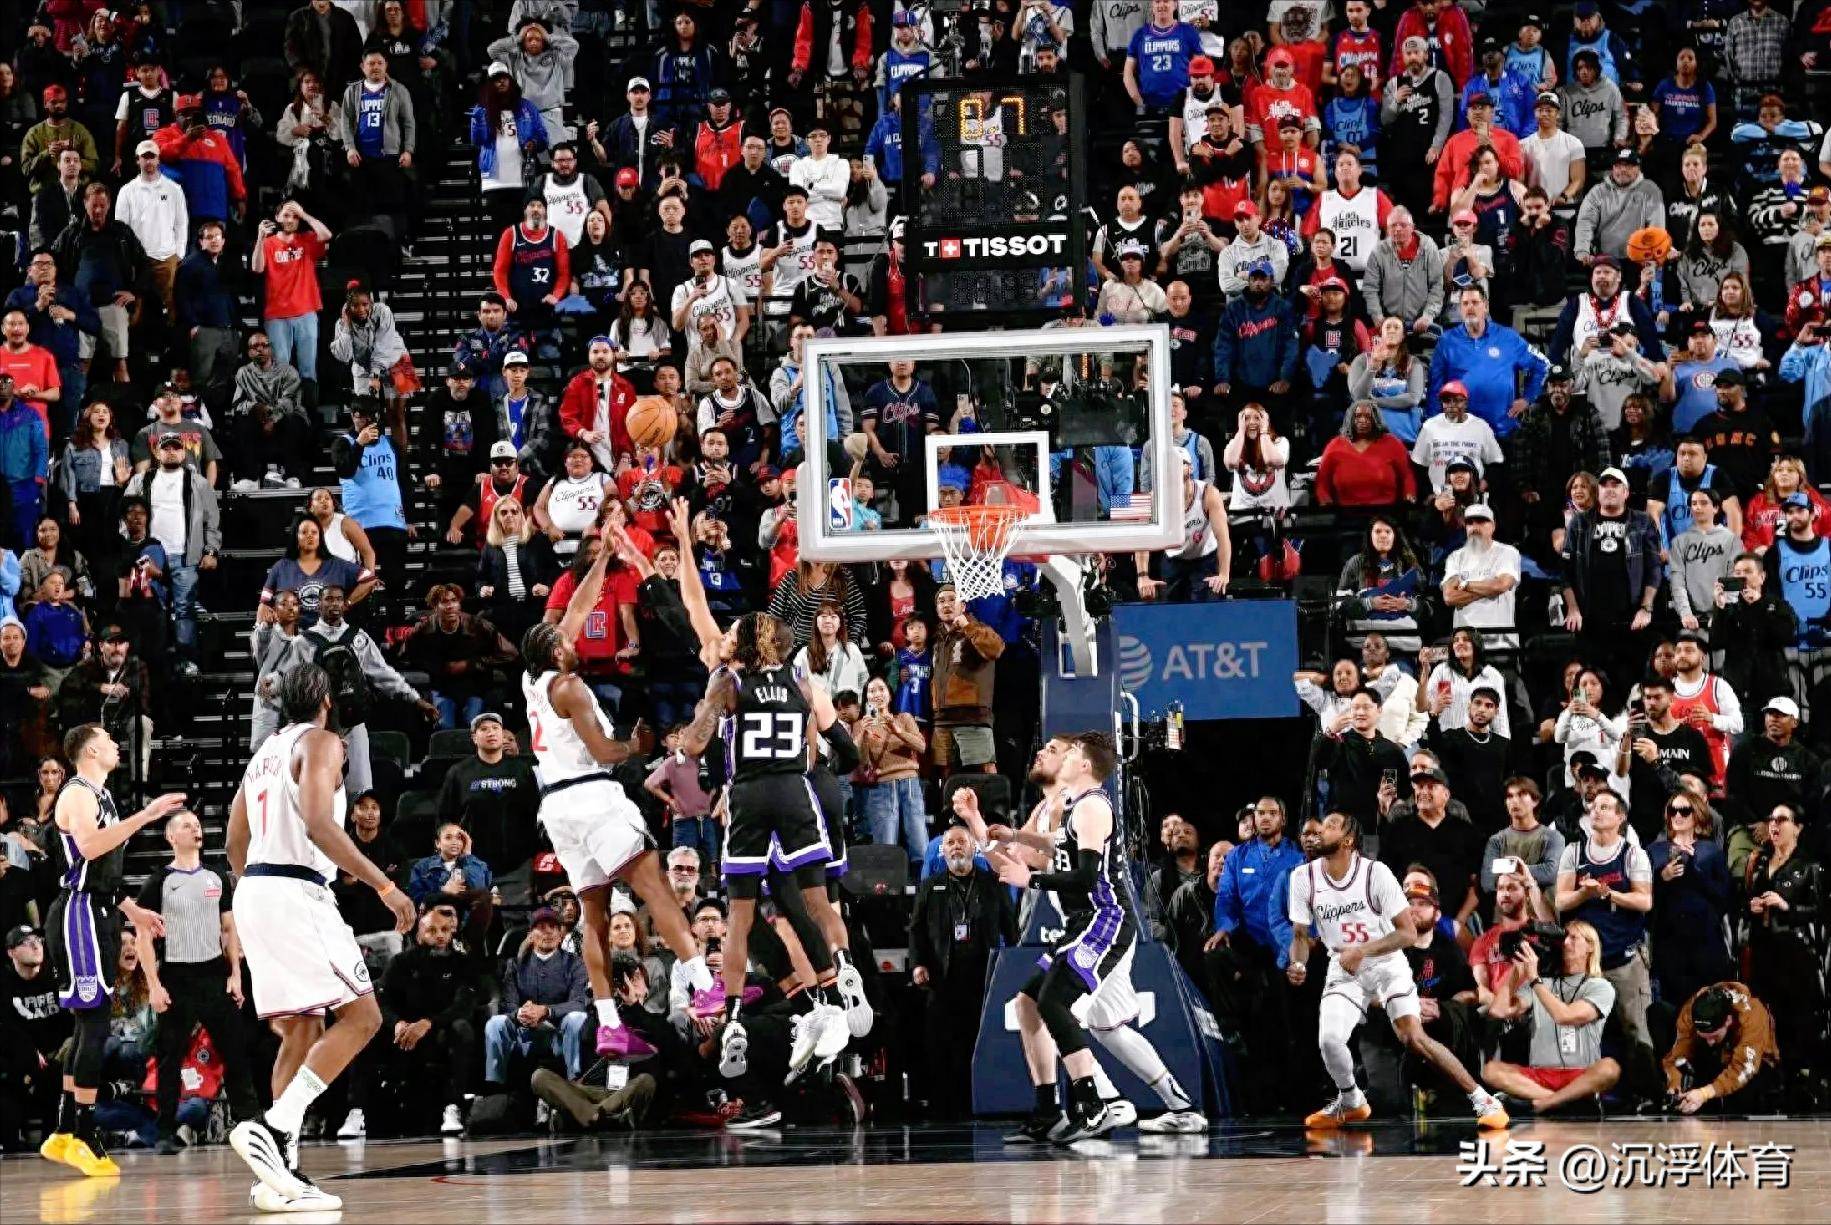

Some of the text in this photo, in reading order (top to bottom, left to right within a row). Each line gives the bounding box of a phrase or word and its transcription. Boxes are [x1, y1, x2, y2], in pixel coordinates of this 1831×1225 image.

[1152, 54, 1171, 72] 23
[1570, 101, 1606, 118] Clips
[367, 112, 380, 127] 13
[963, 234, 1067, 257] TISSOT
[1341, 235, 1357, 256] 21
[531, 267, 550, 283] 32
[1733, 333, 1754, 348] 55
[882, 402, 921, 424] Clips
[577, 496, 597, 511] 55
[1685, 541, 1724, 563] Clips
[1786, 565, 1829, 583] Clips
[1804, 583, 1827, 599] 55
[1162, 641, 1268, 680] AT&T
[755, 686, 788, 703] ELLIS
[528, 710, 548, 752] 2
[743, 712, 803, 758] 23
[1660, 748, 1690, 759] MAIN
[257, 788, 268, 837] 1
[1316, 900, 1366, 922] Clippers
[1340, 921, 1369, 944] 55
